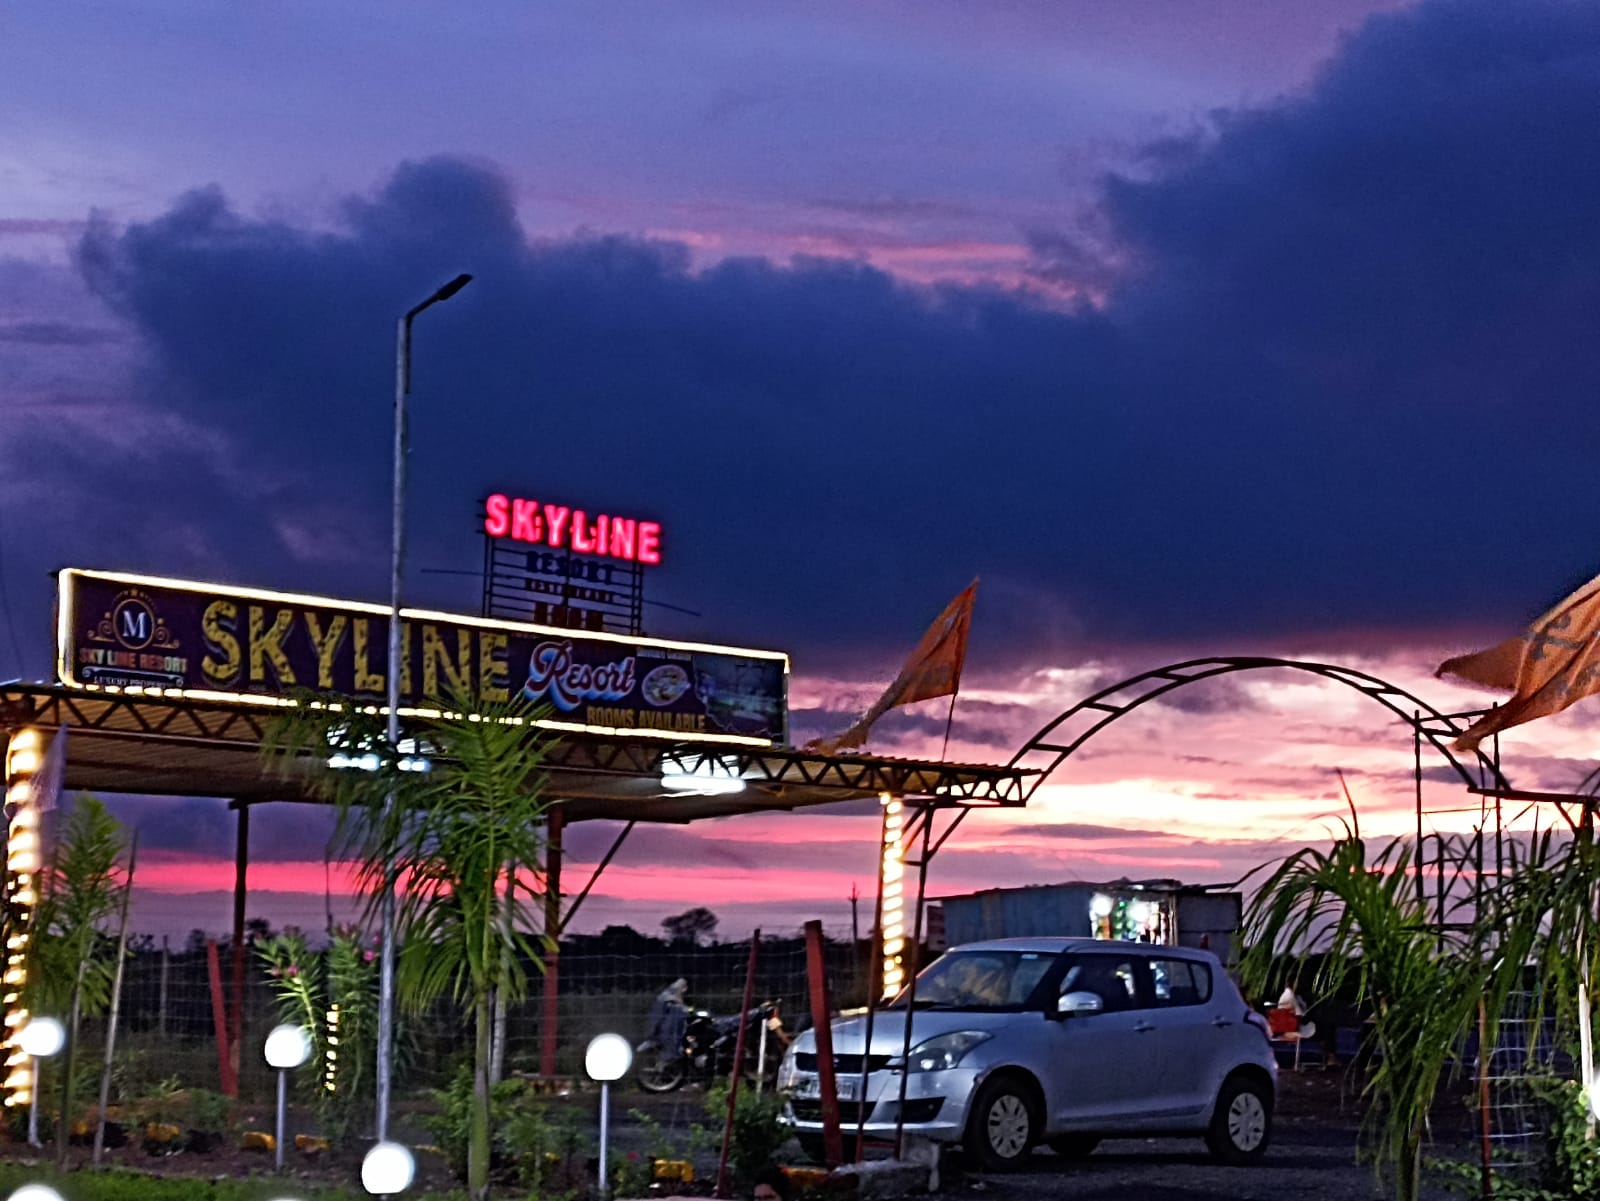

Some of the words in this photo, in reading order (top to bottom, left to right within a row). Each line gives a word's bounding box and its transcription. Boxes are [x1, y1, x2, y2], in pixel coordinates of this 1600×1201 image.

[485, 493, 661, 565] SKYLINE
[122, 610, 146, 638] M
[201, 600, 509, 701] SKYLINE
[525, 640, 636, 712] Resort
[586, 705, 635, 728] ROOMS
[638, 709, 706, 730] AVAILABLE
